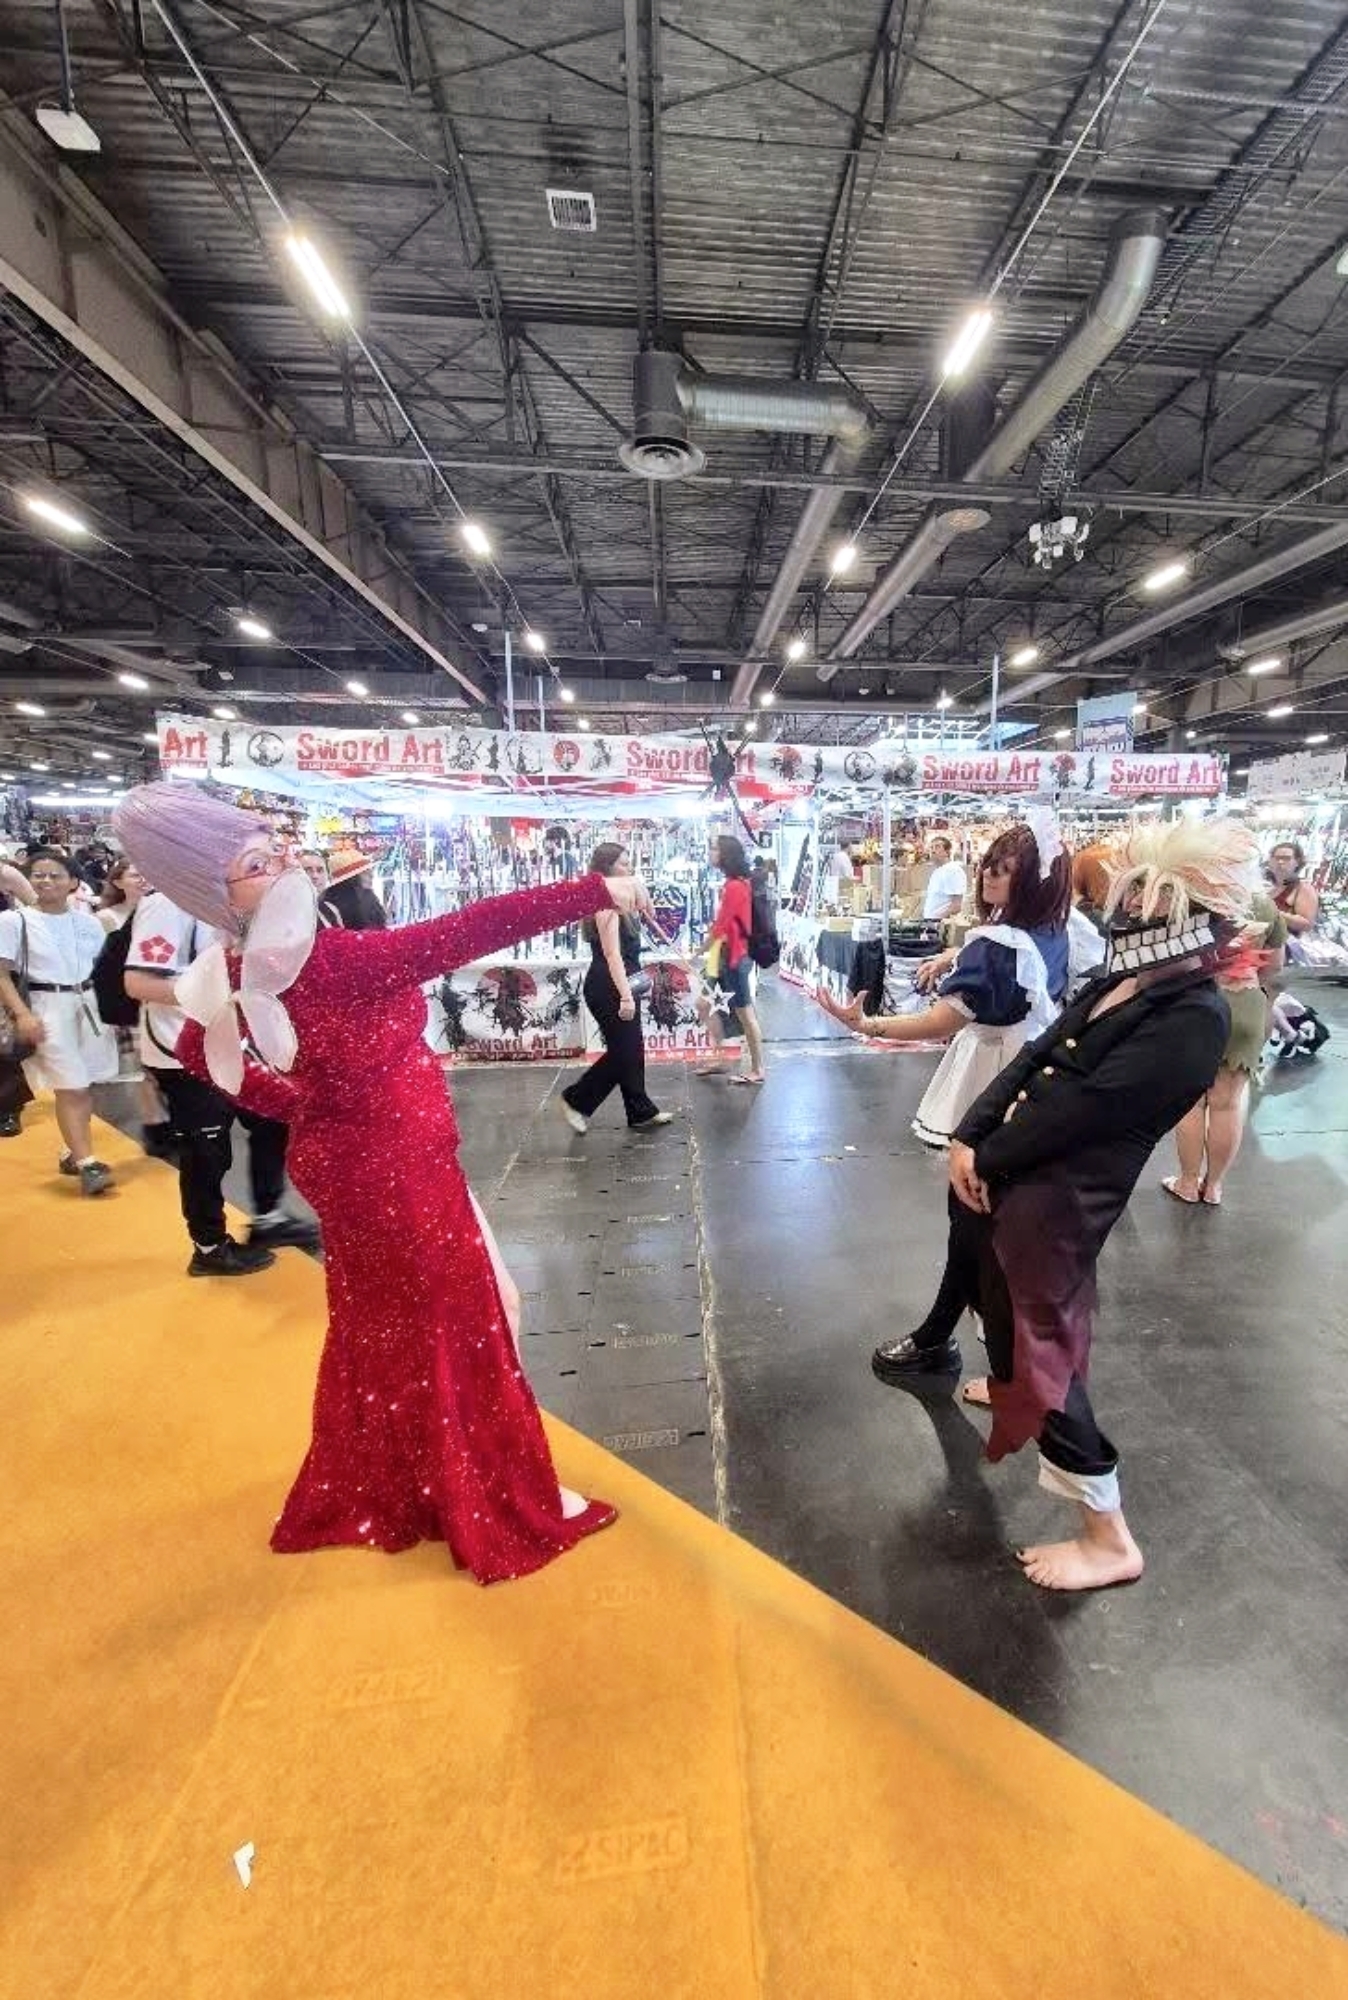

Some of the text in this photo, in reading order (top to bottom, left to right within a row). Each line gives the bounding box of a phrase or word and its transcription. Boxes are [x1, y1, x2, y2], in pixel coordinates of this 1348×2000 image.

[163, 727, 208, 757] Art
[298, 733, 443, 763] Sword Art
[627, 741, 709, 771] Sword
[924, 755, 1040, 781] Sword Art
[1110, 759, 1219, 784] Sword Art
[532, 1034, 558, 1050] Art
[684, 1030, 712, 1047] Art
